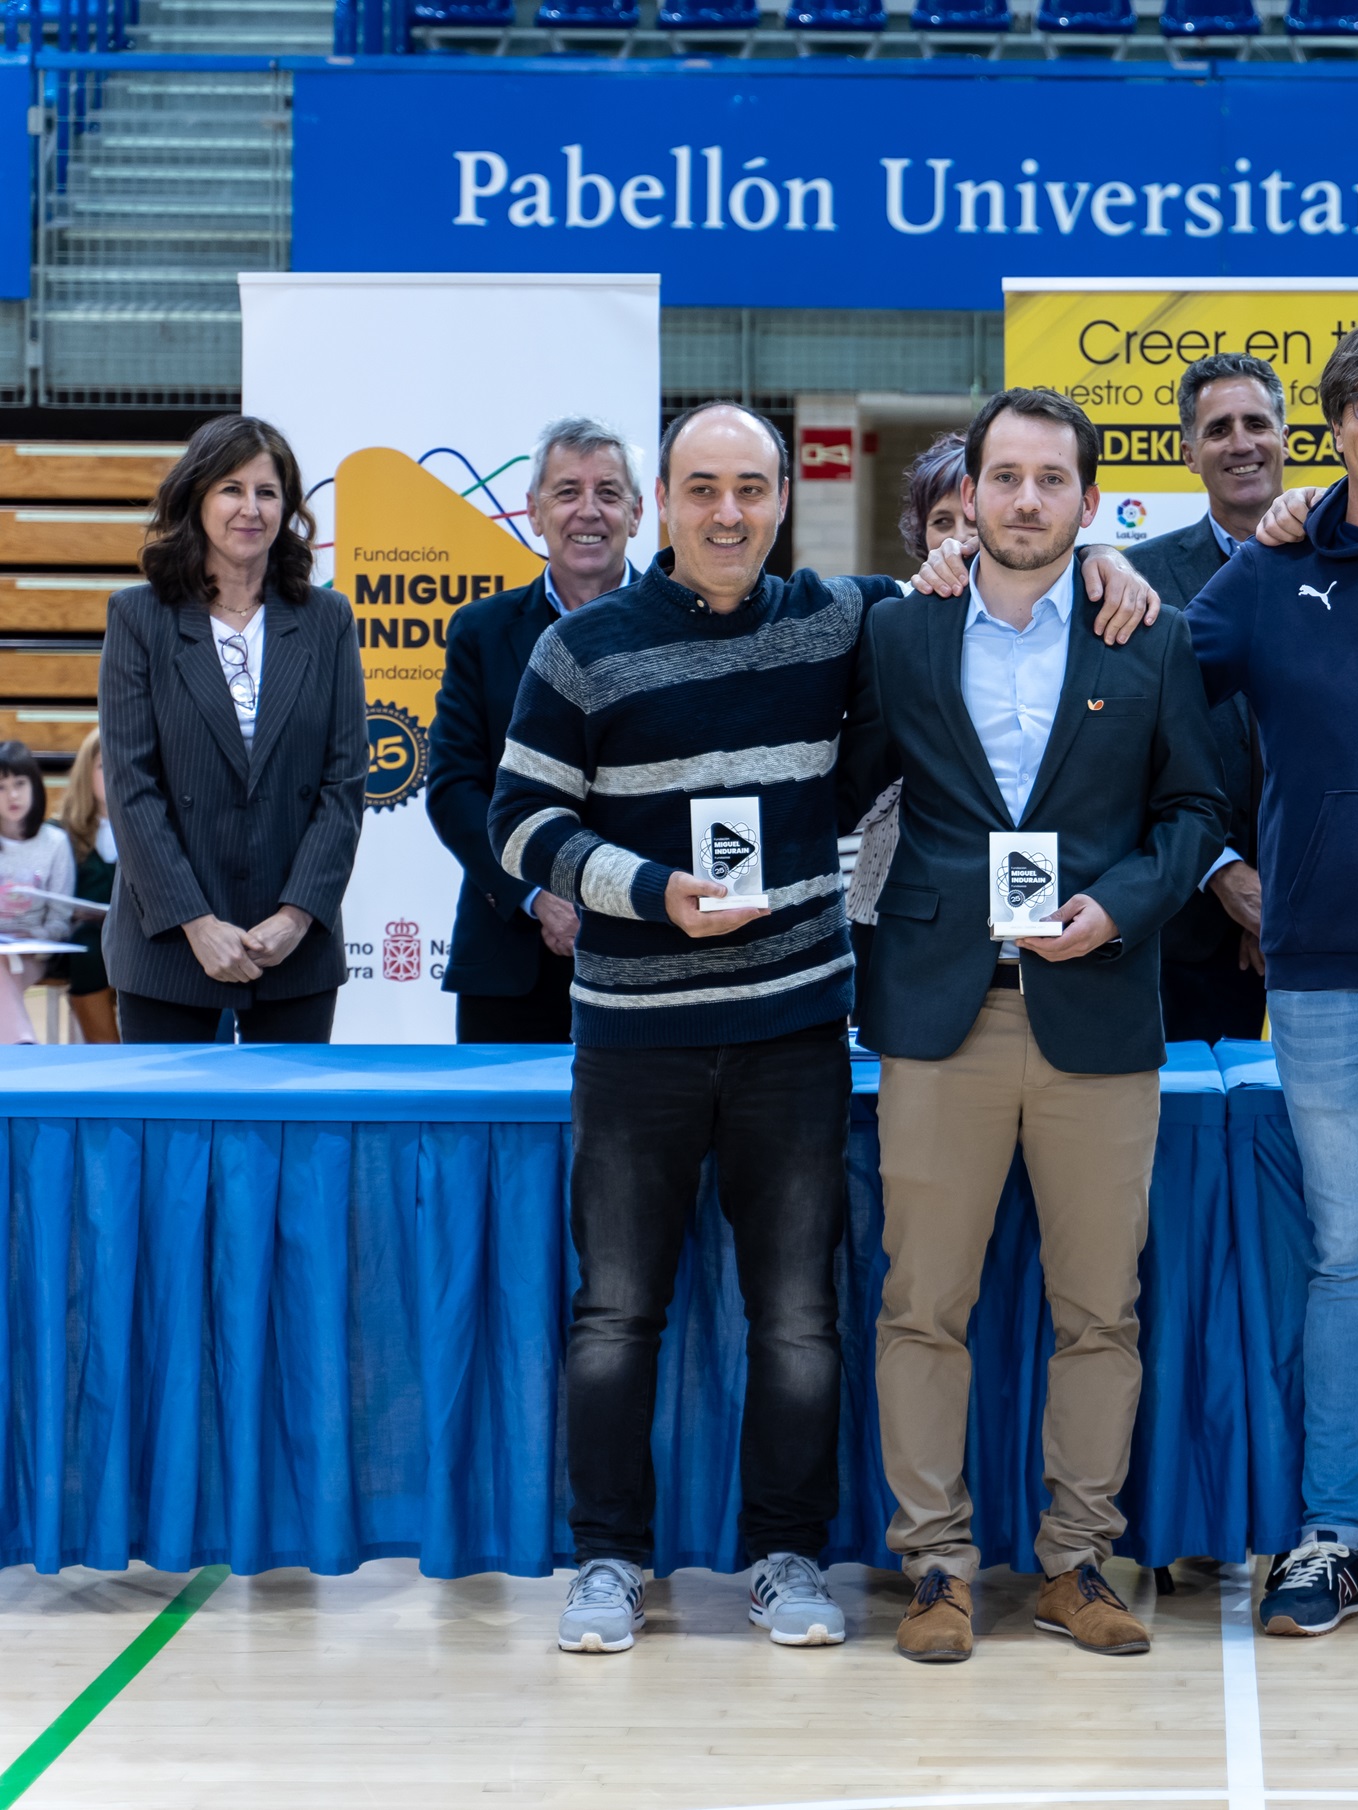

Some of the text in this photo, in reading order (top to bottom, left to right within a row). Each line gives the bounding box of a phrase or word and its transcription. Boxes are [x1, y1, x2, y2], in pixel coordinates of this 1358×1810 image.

[452, 143, 839, 231] Pabellón
[1079, 320, 1226, 365] Creer
[1245, 330, 1311, 365] en
[1116, 531, 1147, 541] LaLiga
[353, 546, 449, 562] Fundación
